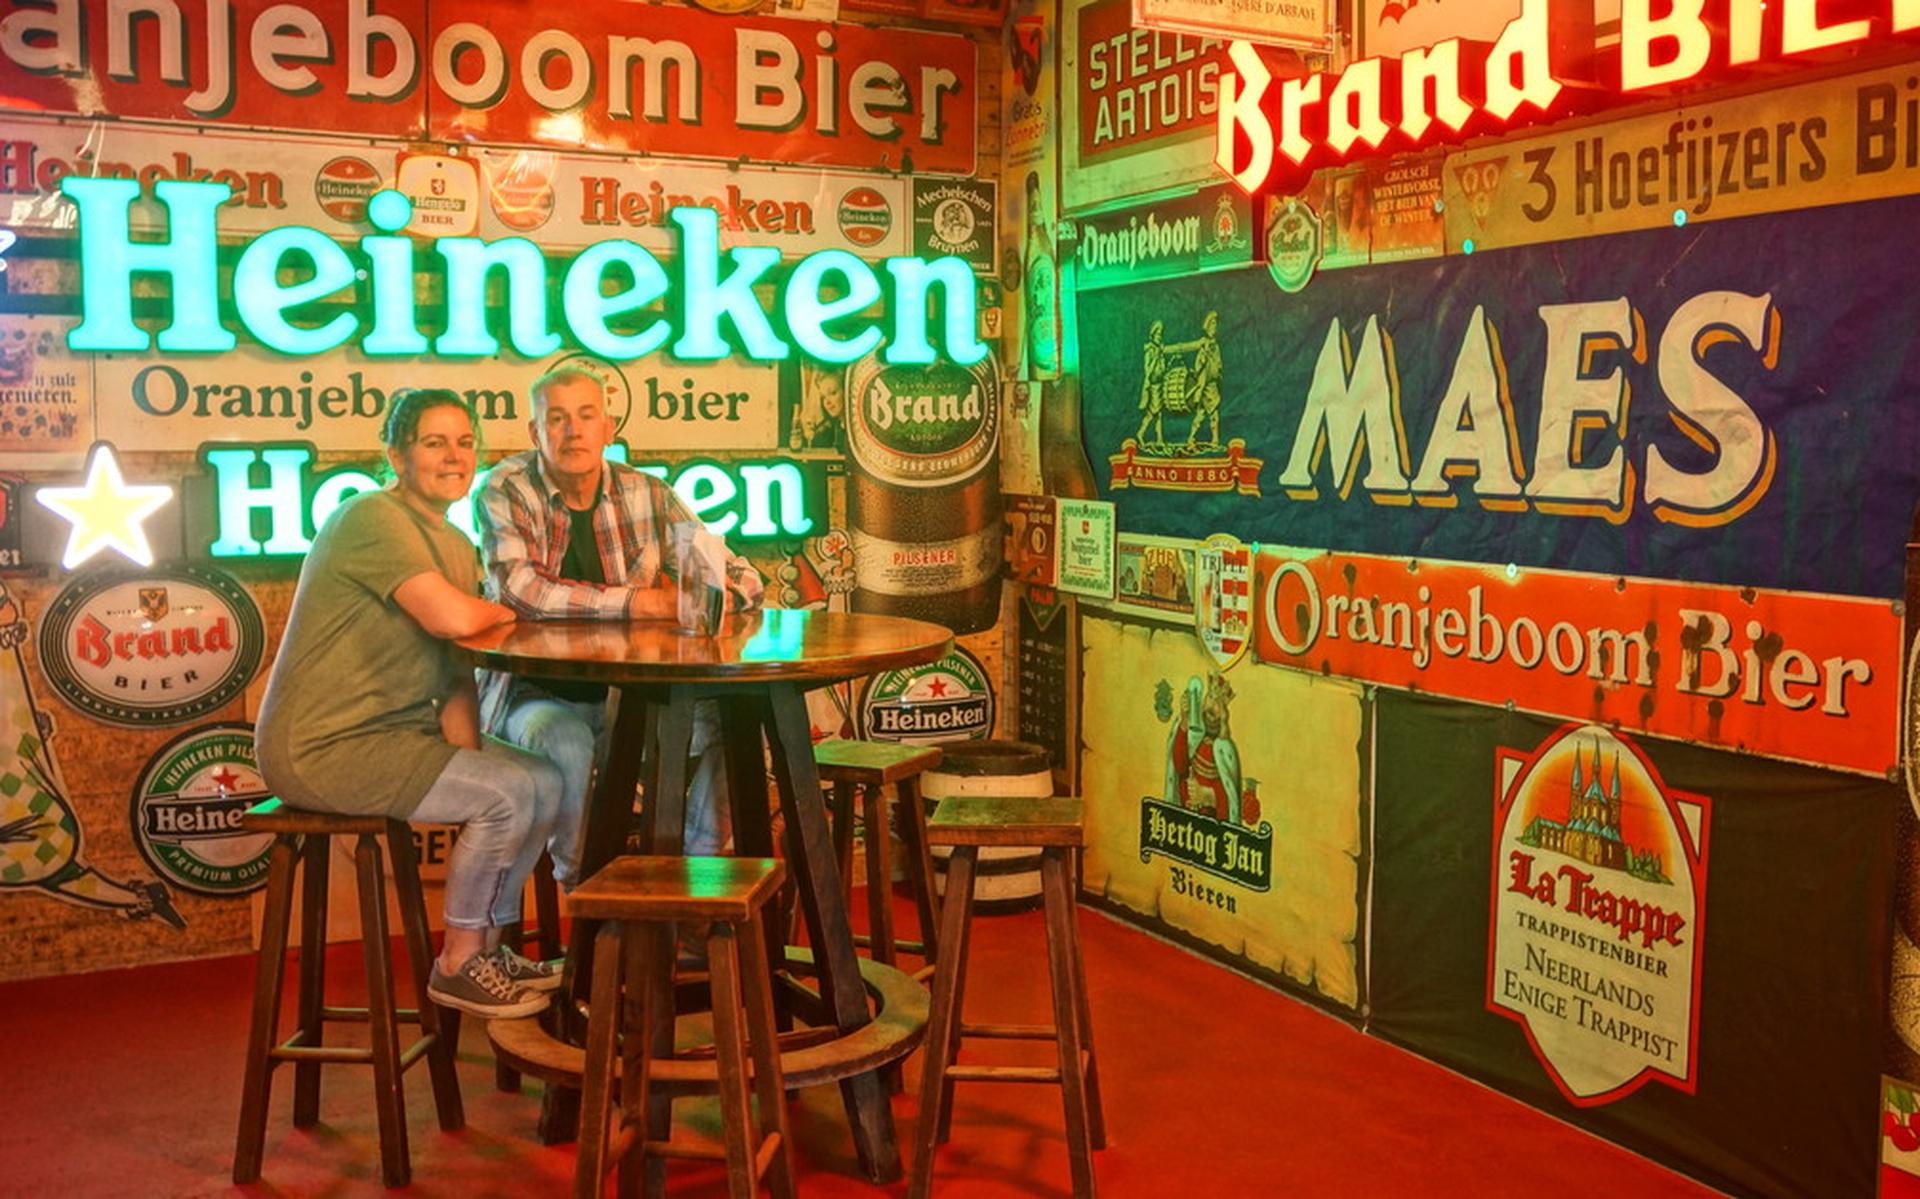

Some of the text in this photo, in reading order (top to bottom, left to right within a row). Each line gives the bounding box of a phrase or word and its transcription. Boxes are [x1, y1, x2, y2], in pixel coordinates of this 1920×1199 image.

[734, 26, 960, 143] Bier
[1093, 62, 1220, 145] ARTOIS
[1217, 0, 1920, 194] Brand BI
[1521, 145, 1557, 223] 3
[1574, 116, 1828, 215] Hoefijzers
[421, 214, 455, 226] BIER
[63, 177, 989, 364] Heineken
[132, 364, 517, 430] Oranjebm
[645, 377, 750, 421] bier
[870, 377, 981, 430] Brand
[1278, 290, 1780, 528] MAES
[207, 443, 813, 556] Heen
[1135, 466, 1229, 482] ANNO 1880
[893, 549, 955, 566] PILSENER
[75, 613, 234, 669] Brand
[1265, 560, 1873, 717] Oranjeboom Bier
[114, 669, 199, 691] BIER
[879, 705, 985, 731] Heineken
[164, 743, 257, 787] HEINEKEN PILS
[155, 801, 254, 832] Heine
[1149, 807, 1264, 878] Hertog Jan
[168, 850, 233, 881] PREMIUM
[1169, 866, 1236, 914] Bieren
[1507, 850, 1686, 950] La Trappe
[1517, 911, 1669, 978] TRAPPISTENBIER
[1525, 942, 1655, 1017] NEERLANDS
[1504, 969, 1679, 1062] ENIGE TRAPPIST
